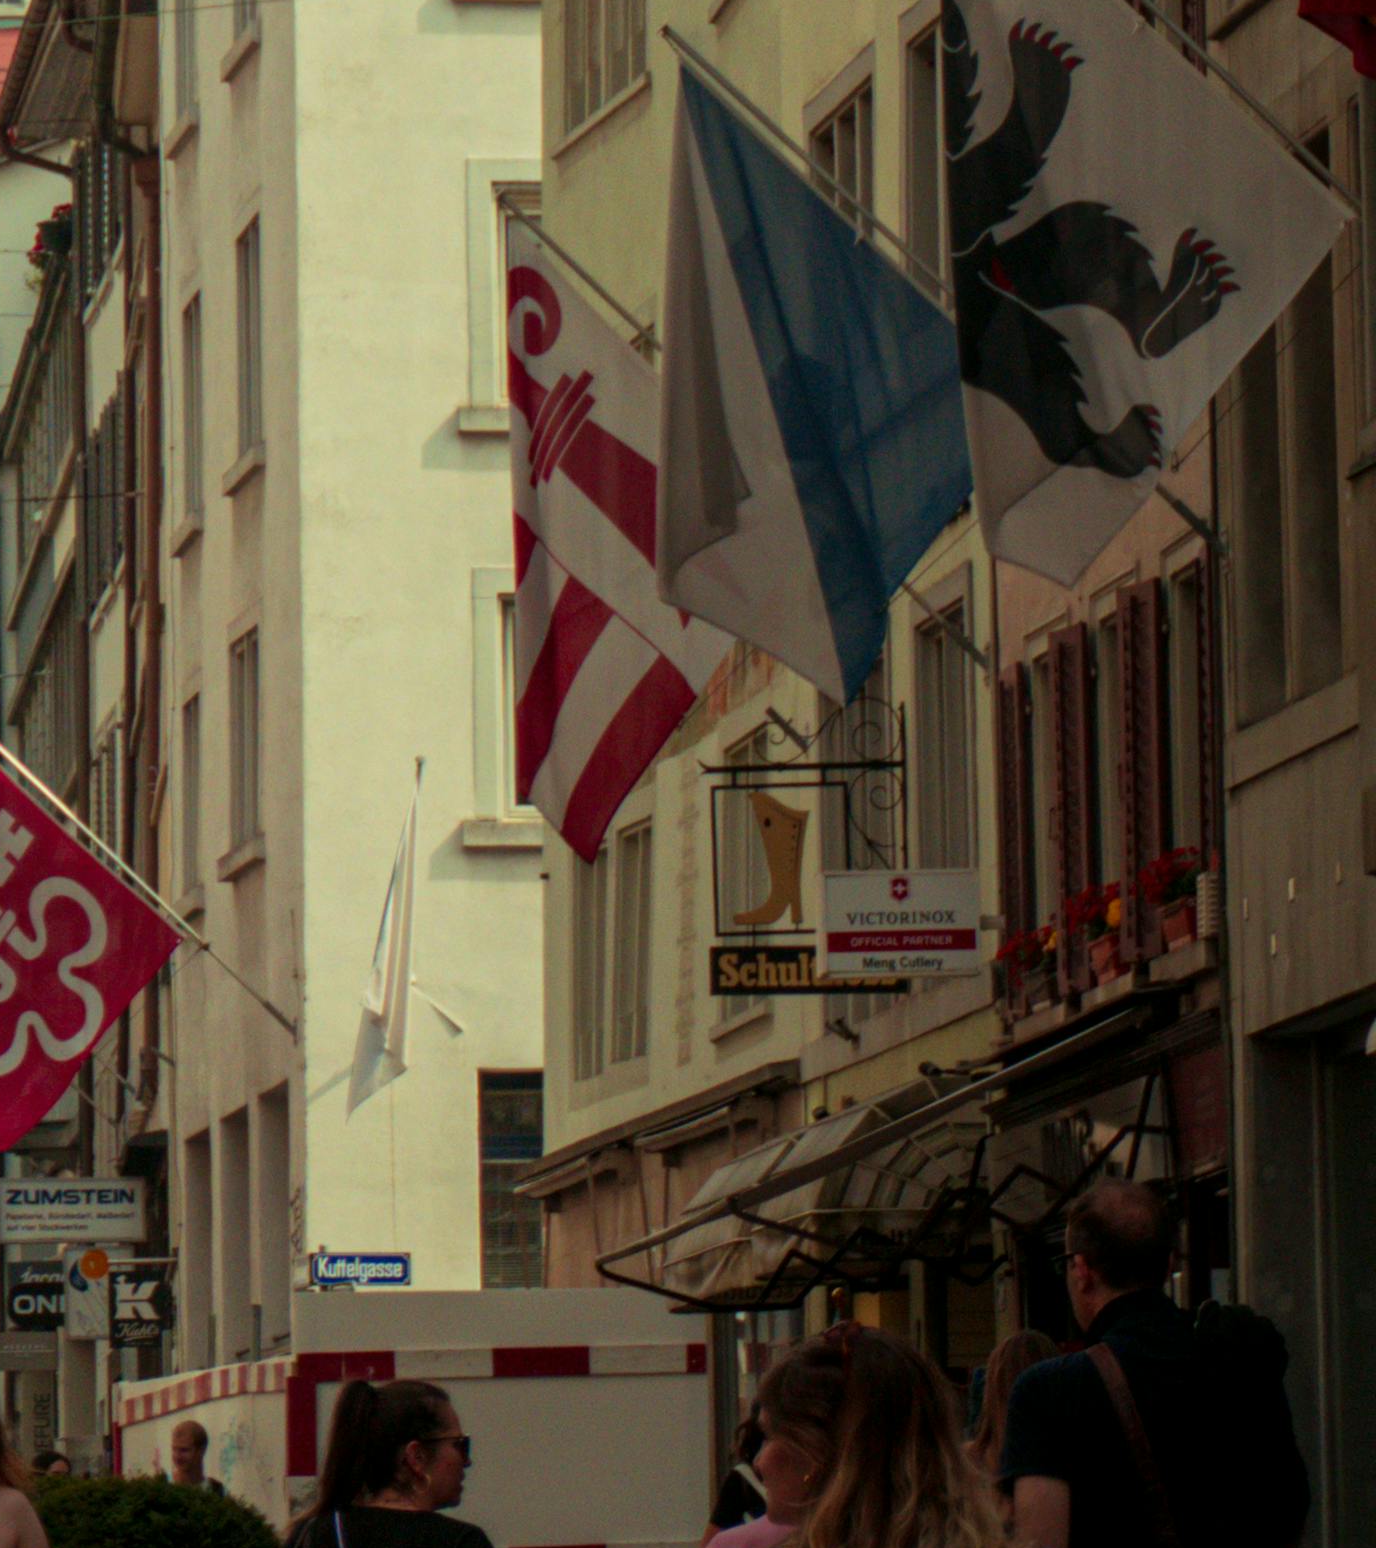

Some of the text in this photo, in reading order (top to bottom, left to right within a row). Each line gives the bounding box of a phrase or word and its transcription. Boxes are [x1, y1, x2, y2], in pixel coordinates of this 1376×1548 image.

[846, 910, 956, 925] VICTORINOX
[850, 932, 953, 947] OFFICIAL PARTNER
[862, 955, 943, 970] Meng Cutlery
[6, 1189, 135, 1205] ZUMSTEIN
